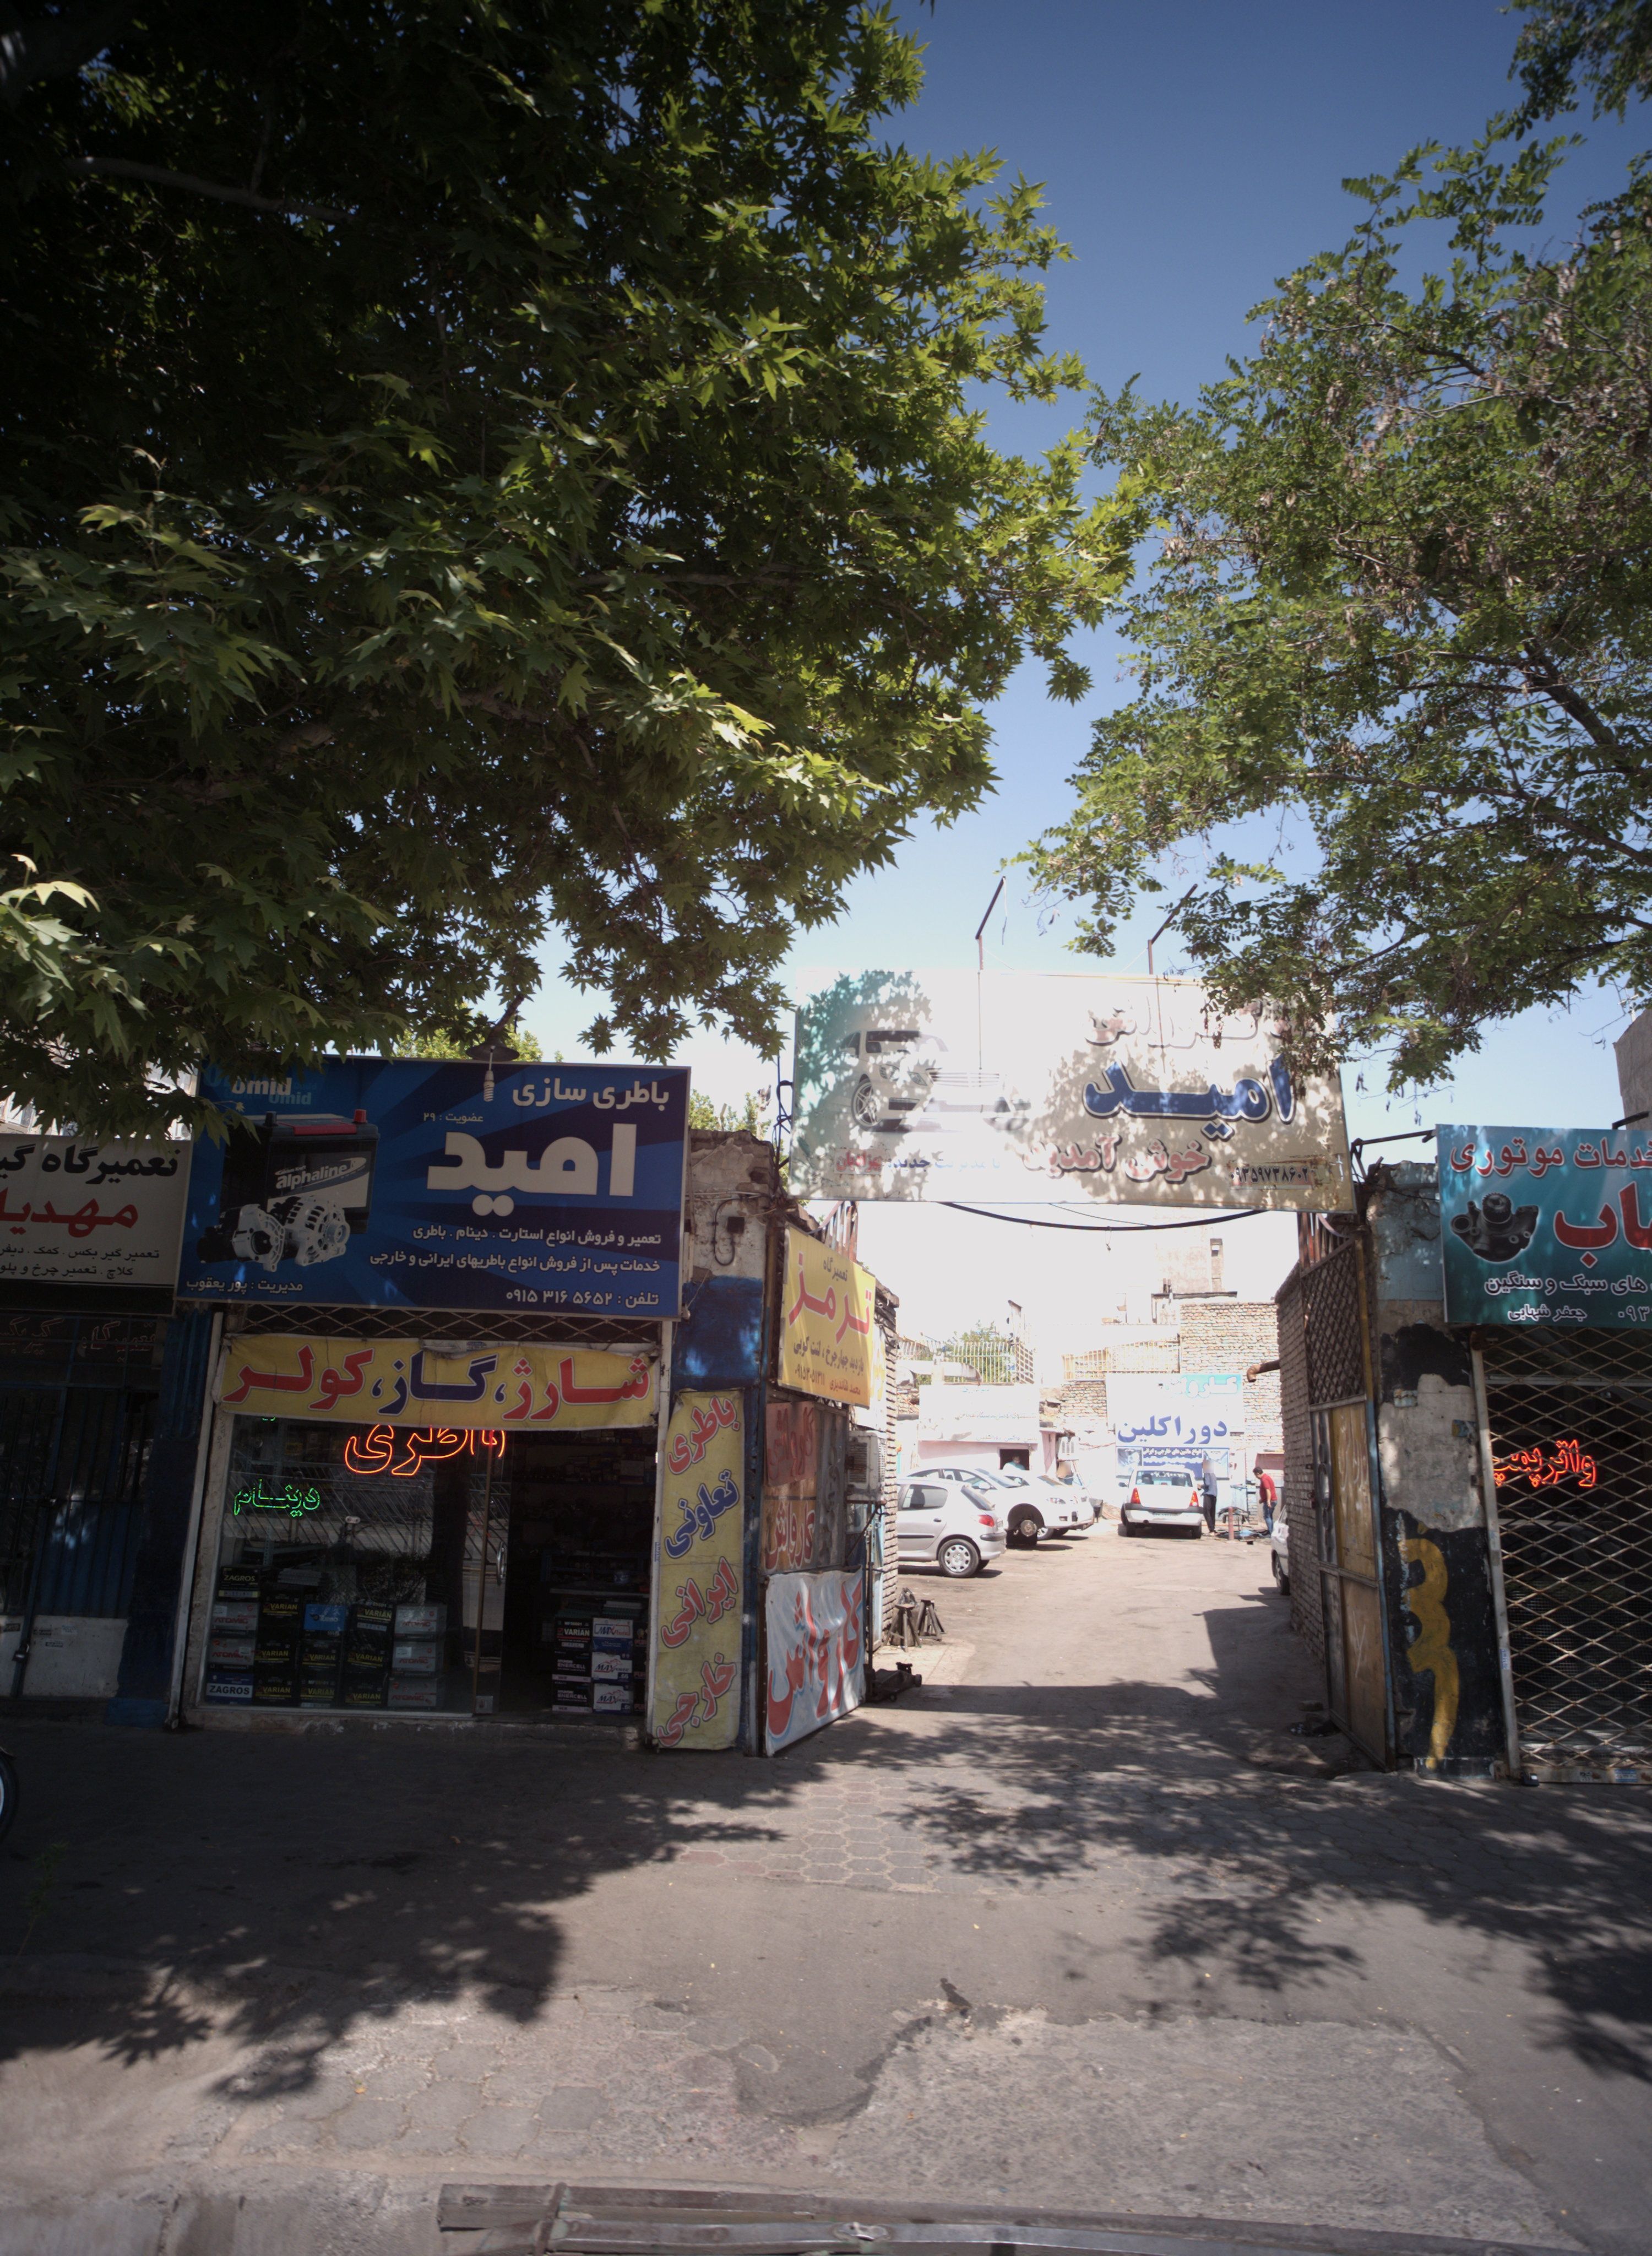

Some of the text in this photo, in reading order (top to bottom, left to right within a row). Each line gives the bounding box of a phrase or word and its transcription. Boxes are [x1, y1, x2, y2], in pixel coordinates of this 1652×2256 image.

[512, 1077, 670, 1111] باطری سازی
[1083, 1054, 1295, 1141] امید
[1125, 1138, 1212, 1184] خوش
[1449, 1137, 1565, 1178] موتوری
[275, 1164, 348, 1190] alphaline
[426, 1122, 638, 1217] امید
[413, 1224, 662, 1248] تعمیر و فروش انواع استارت دینام باطری
[33, 1246, 59, 1255] کمک
[68, 1248, 98, 1261] بکس
[124, 1249, 160, 1261] تعمیر
[369, 1251, 407, 1265] خارجی
[408, 1254, 416, 1266] و
[418, 1252, 454, 1267] ایرانی
[508, 1256, 537, 1273] انواع
[539, 1255, 578, 1271] فروش
[579, 1257, 591, 1272] از
[620, 1260, 661, 1272] خدمات
[20, 1264, 29, 1275] و
[31, 1263, 59, 1277] چرخ
[61, 1266, 97, 1277] تعمیر
[106, 1266, 133, 1279] کلاچ
[593, 1262, 618, 1276] پس
[186, 1277, 303, 1294] مدیریت پور یعقوب
[1484, 1270, 1543, 1296] سنگین
[1544, 1277, 1558, 1296] و
[1559, 1273, 1608, 1295] سبک
[624, 1292, 660, 1308] تلفن
[788, 1252, 872, 1346] ترمز
[1507, 1303, 1588, 1322] جعفر شهابی
[222, 1344, 375, 1411] کولر
[667, 1395, 741, 1476] باطری
[233, 1478, 321, 1518] دینام
[665, 1469, 741, 1559] تعاونی
[660, 1556, 739, 1649] ایرانی
[364, 1608, 392, 1619] VARIAN
[563, 1628, 590, 1636] VARIAN
[355, 1652, 383, 1662] VARIAN
[209, 1685, 250, 1695] ZAGROS
[656, 1653, 737, 1748] خارجی
